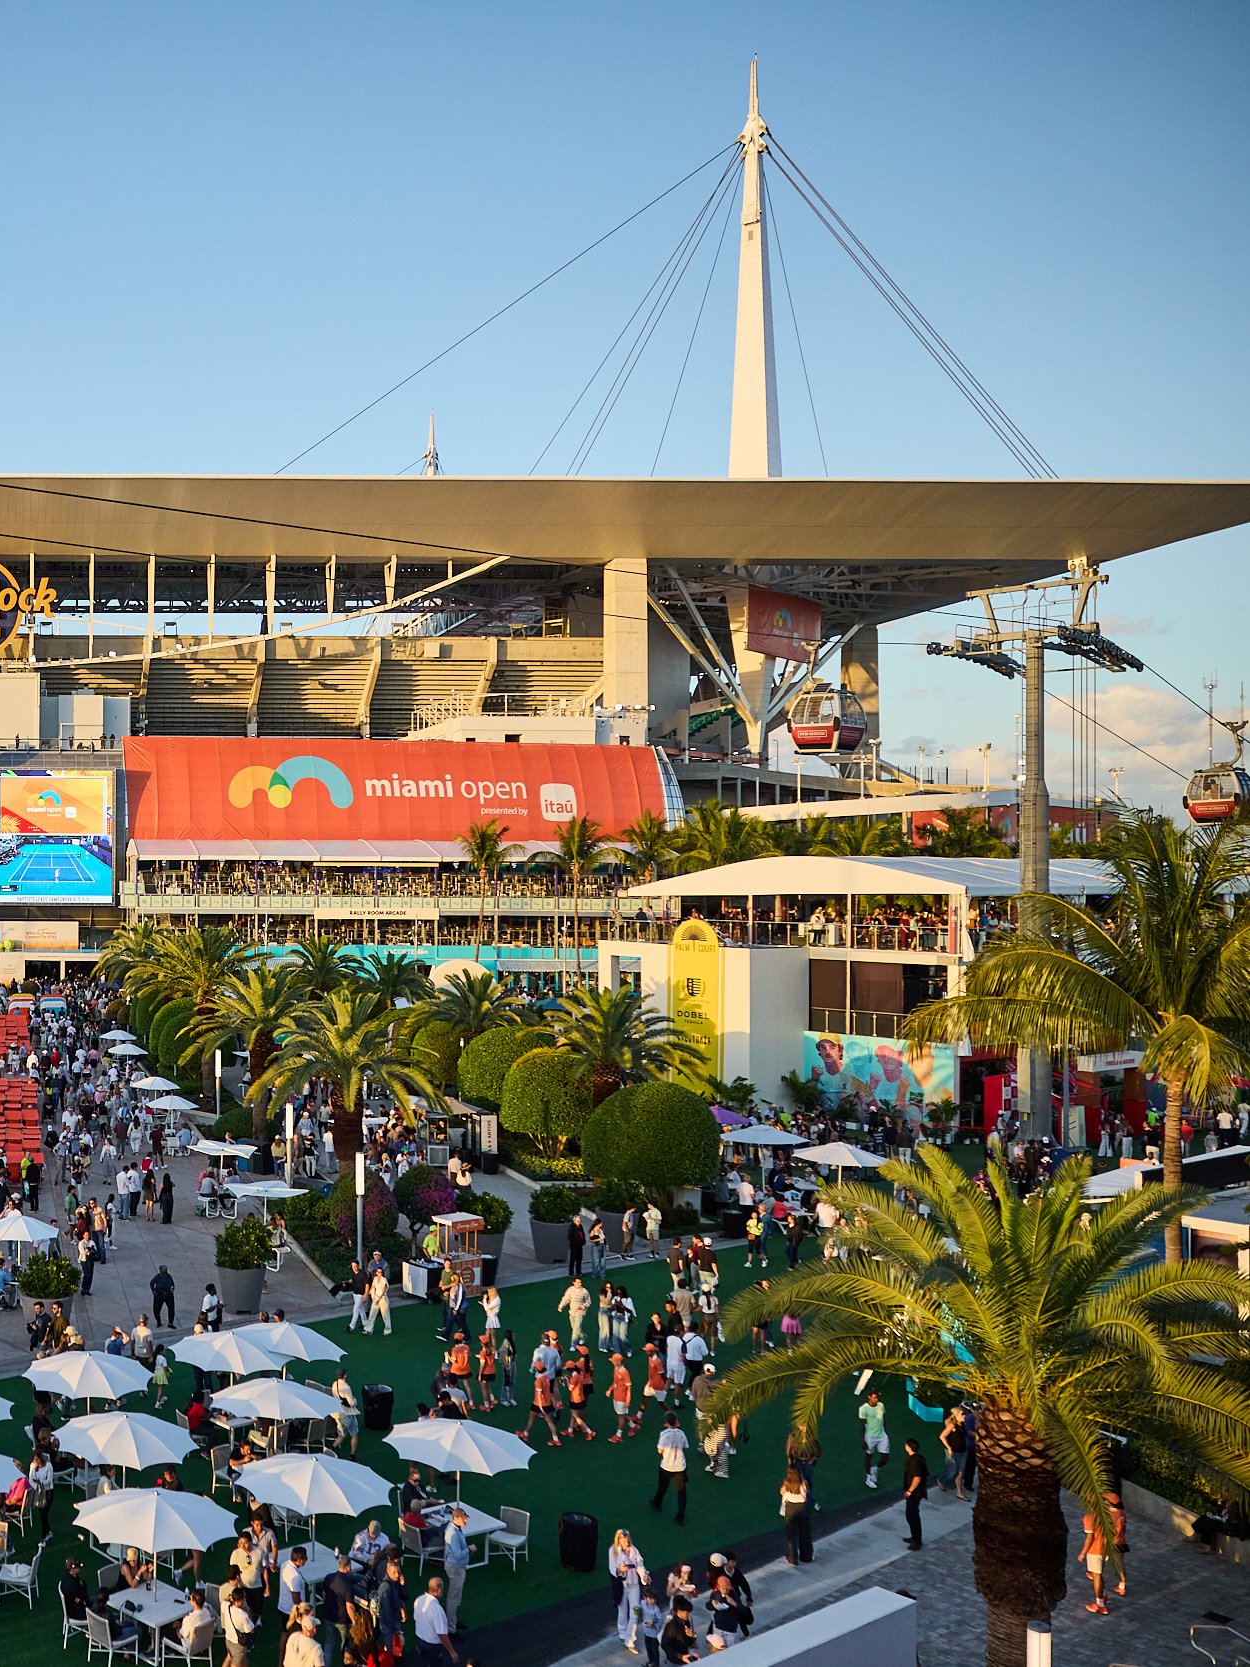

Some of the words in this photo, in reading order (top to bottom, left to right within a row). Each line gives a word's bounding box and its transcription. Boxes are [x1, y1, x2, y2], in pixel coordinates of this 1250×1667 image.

[365, 773, 453, 798] miami
[461, 779, 527, 804] open
[543, 798, 574, 815] itaú
[480, 807, 516, 817] presented
[518, 807, 527, 816] by
[676, 943, 690, 951] PALM
[698, 944, 716, 952] COURT
[677, 1010, 709, 1020] DOBEL
